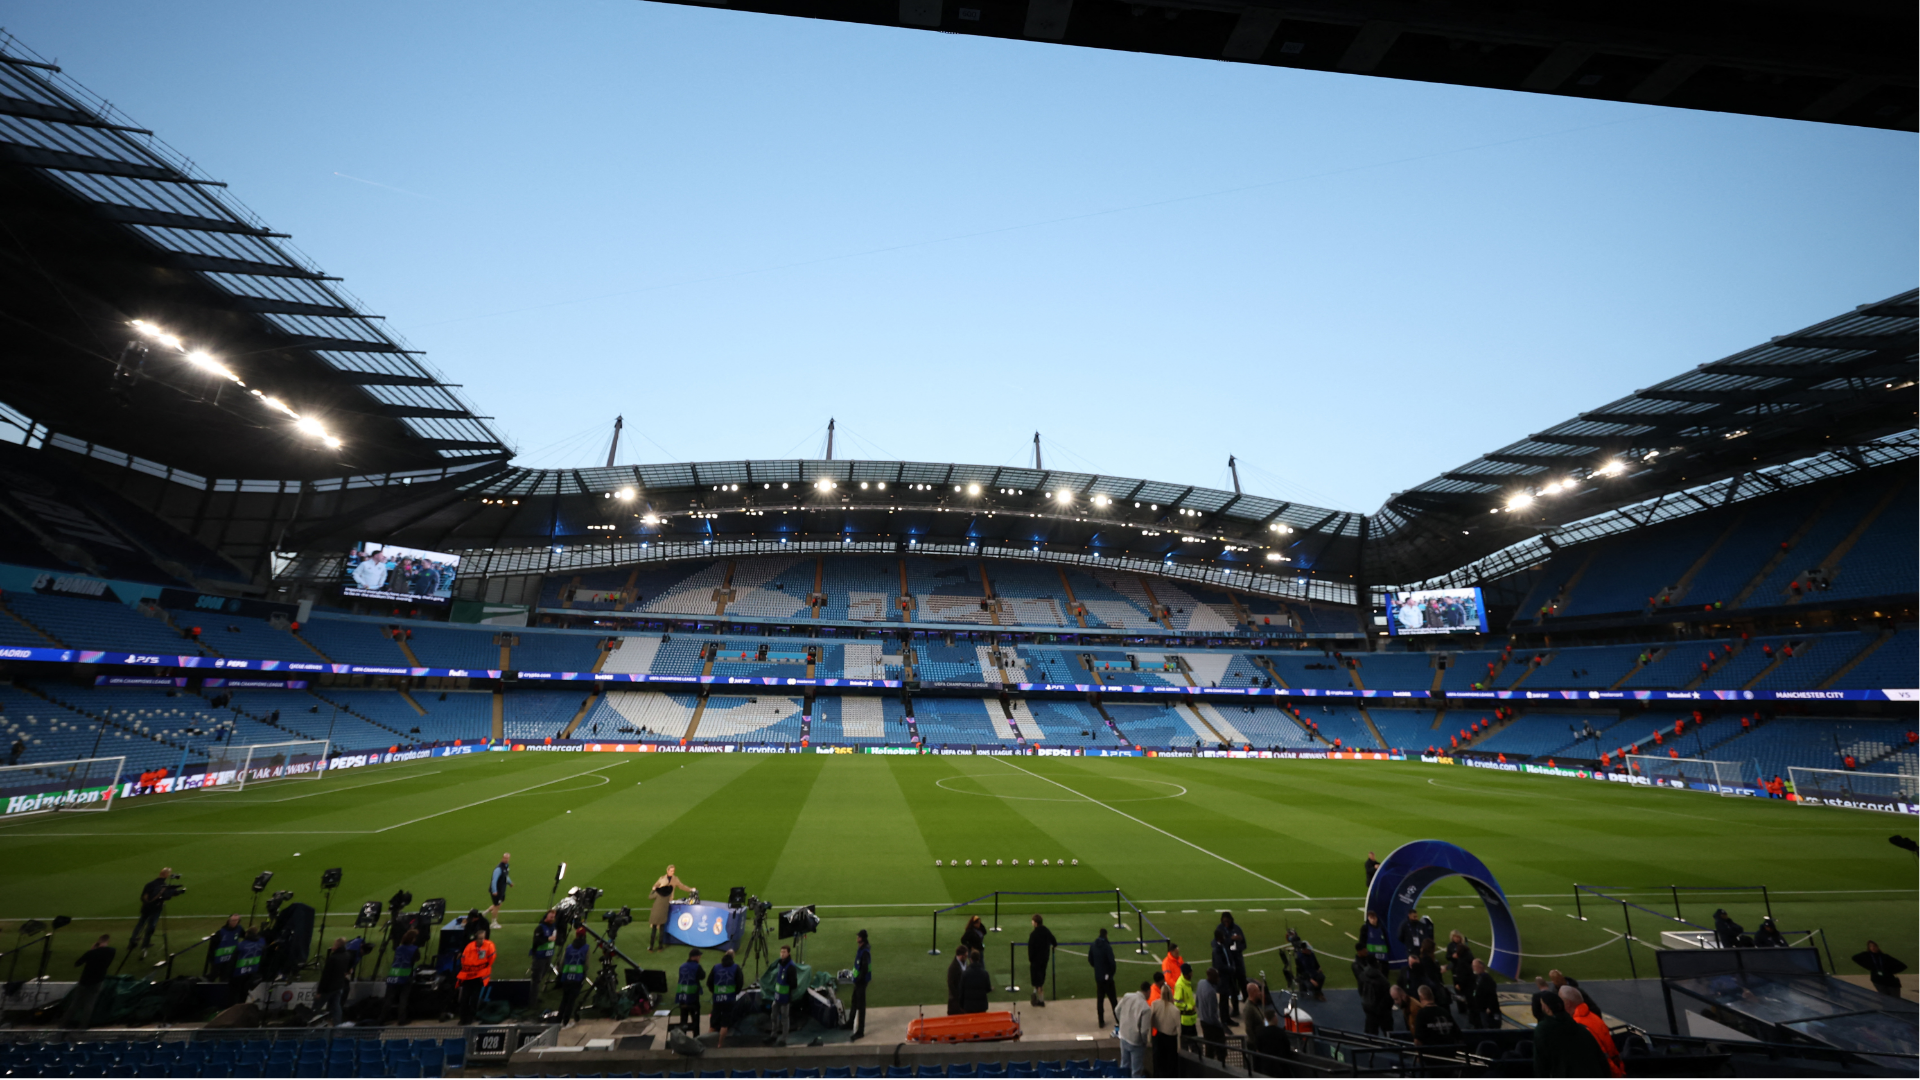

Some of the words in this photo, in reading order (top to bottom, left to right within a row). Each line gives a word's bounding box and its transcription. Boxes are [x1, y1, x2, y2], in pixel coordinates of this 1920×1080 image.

[31, 573, 51, 589] IS
[52, 576, 107, 596] COMING
[195, 595, 226, 610] SOON
[136, 656, 160, 664] PS5
[227, 660, 248, 668] PEPSI
[451, 746, 472, 755] PS5
[527, 744, 582, 752] mastercard
[393, 749, 430, 762] crypto.com
[329, 755, 367, 770] PEPSI
[1474, 761, 1517, 771] crypto.com
[1526, 764, 1576, 777] Heineken
[482, 1036, 500, 1049] 028
